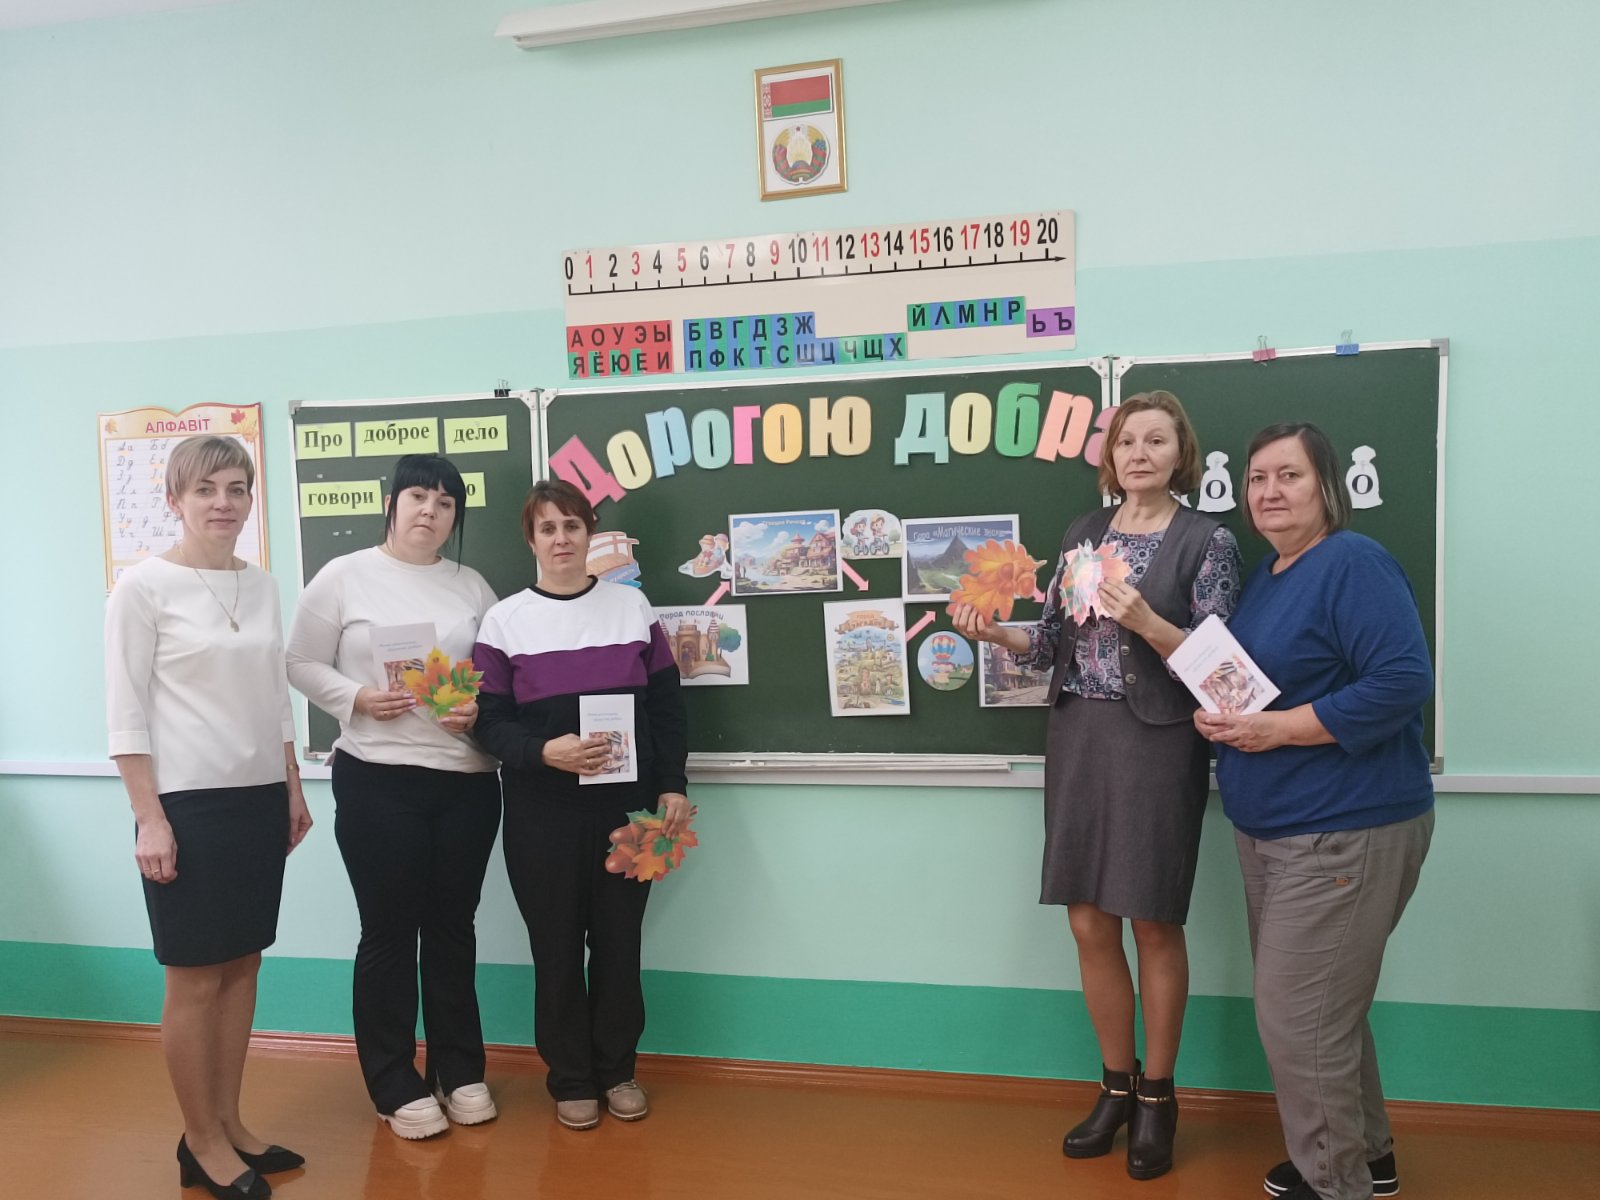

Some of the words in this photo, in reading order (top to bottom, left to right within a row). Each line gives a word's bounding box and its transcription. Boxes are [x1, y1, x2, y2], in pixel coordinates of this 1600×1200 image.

[565, 257, 573, 280] 0
[586, 255, 592, 279] 1
[609, 254, 618, 277] 2
[632, 251, 640, 275] 3
[653, 250, 662, 273] 4
[677, 248, 687, 272] 5
[700, 246, 709, 270] 6
[726, 244, 735, 268] 7
[746, 242, 755, 267] 8
[770, 240, 779, 265] 9
[789, 238, 807, 263] 10
[813, 236, 829, 262] 11
[836, 234, 855, 260] 12
[861, 232, 880, 258] 13
[884, 230, 903, 256] 14
[910, 228, 930, 254] 15
[934, 226, 953, 252] 16
[961, 224, 980, 250] 17
[984, 222, 1004, 248] 18
[1010, 220, 1030, 246] 19
[1037, 218, 1058, 245] 20
[145, 419, 211, 434] АЛФАВІТ
[304, 431, 343, 452] Про
[364, 423, 430, 445] доброе
[454, 425, 498, 444] дело
[308, 490, 374, 509] говори
